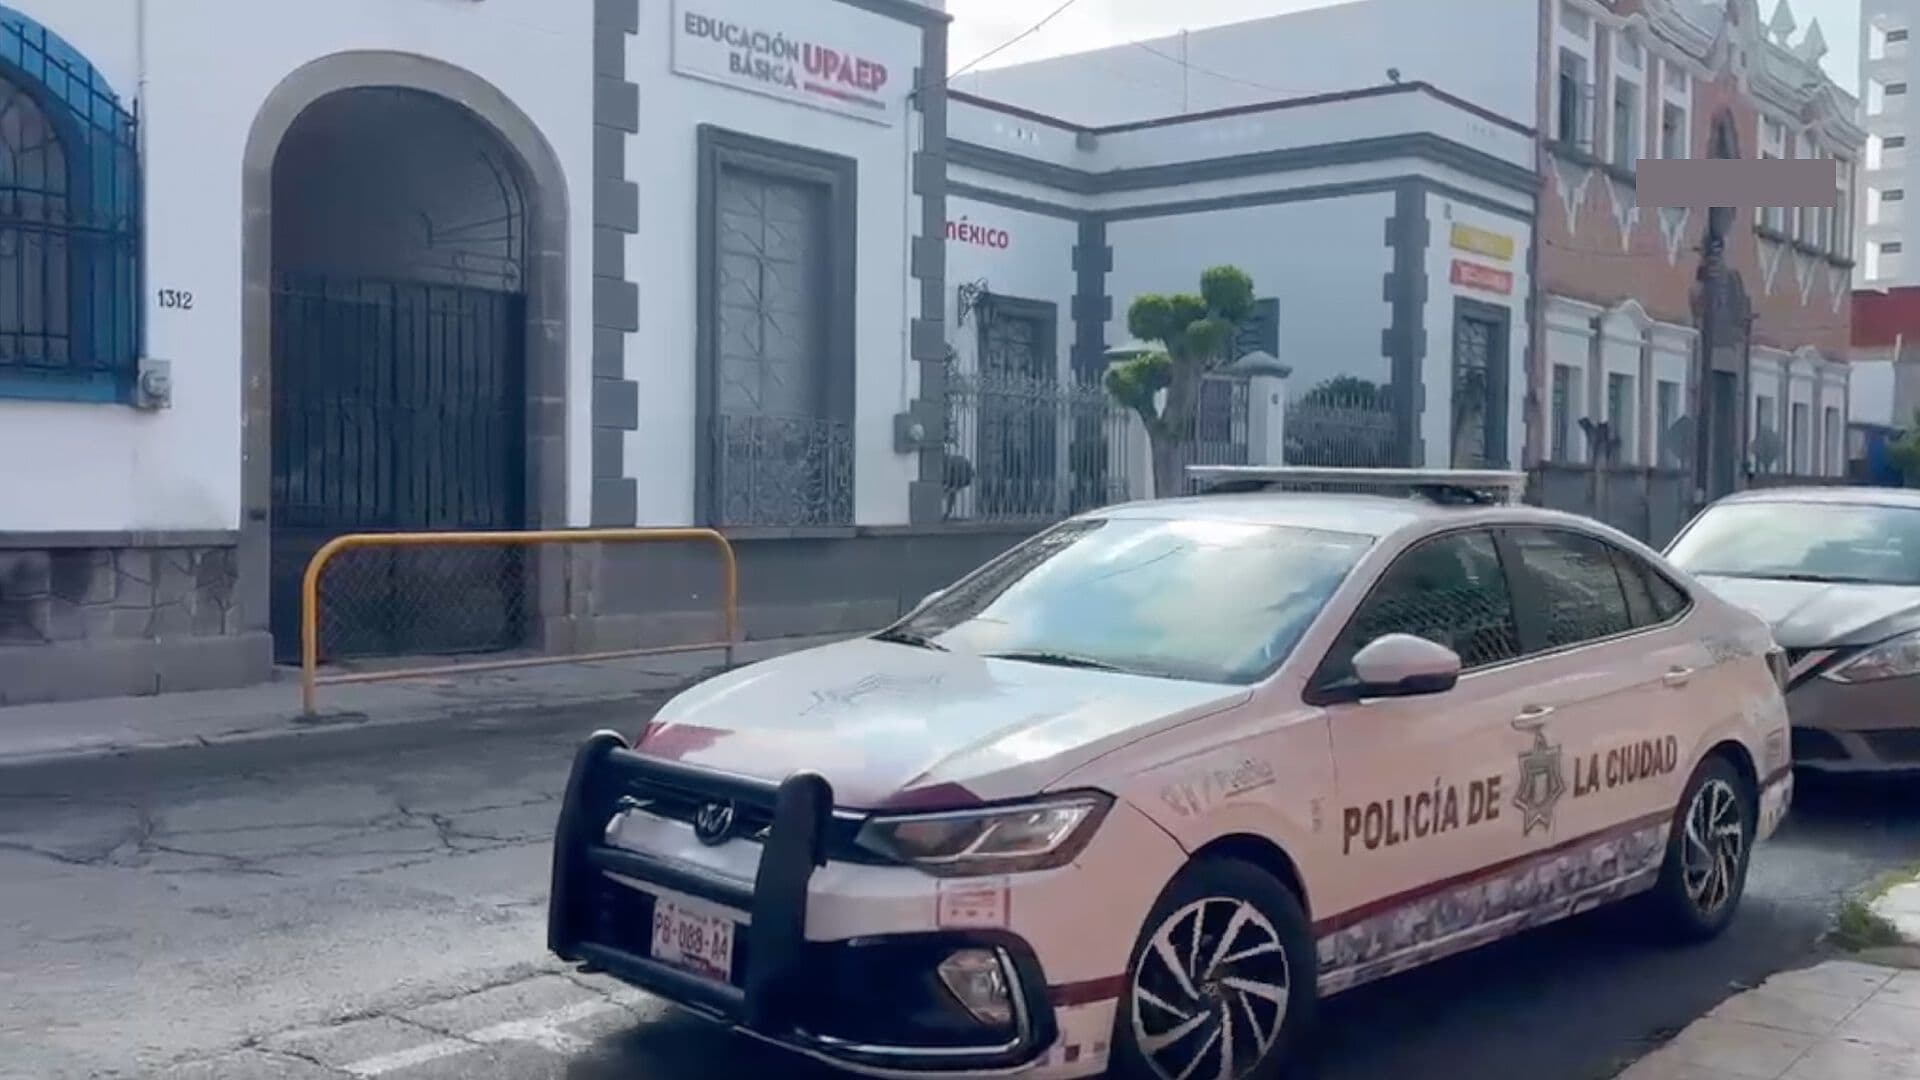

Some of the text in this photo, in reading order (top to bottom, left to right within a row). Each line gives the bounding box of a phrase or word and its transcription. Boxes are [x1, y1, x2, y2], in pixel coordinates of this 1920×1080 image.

[685, 12, 799, 62] EDUCACIÓN
[729, 50, 798, 90] BÁSICA
[803, 43, 887, 92] UPAEP
[158, 288, 193, 309] 1312
[1342, 776, 1459, 856] POLICÍA
[1467, 774, 1502, 826] DE
[1573, 755, 1600, 798] LA
[1604, 734, 1678, 789] CIUDAD
